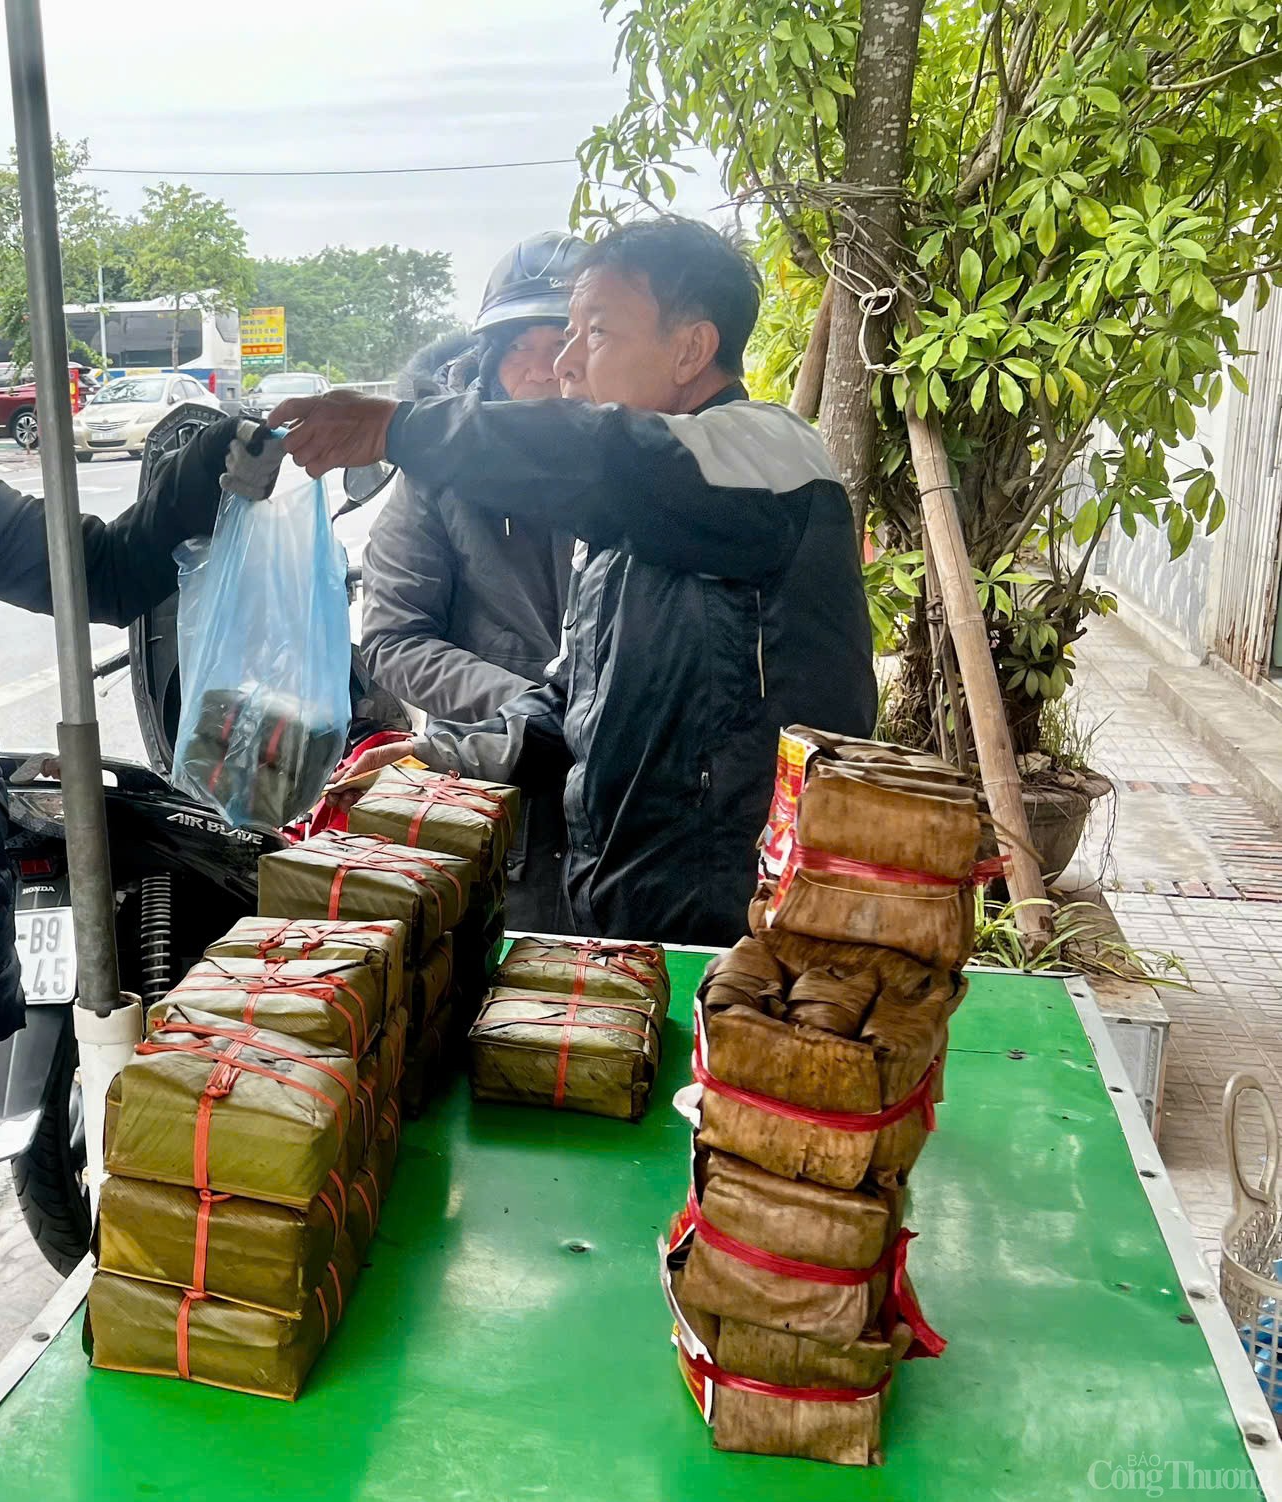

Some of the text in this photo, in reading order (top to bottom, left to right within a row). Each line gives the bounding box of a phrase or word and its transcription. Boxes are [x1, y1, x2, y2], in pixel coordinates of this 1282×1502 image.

[167, 813, 264, 845] AIR BLADE
[21, 885, 56, 895] HONDA
